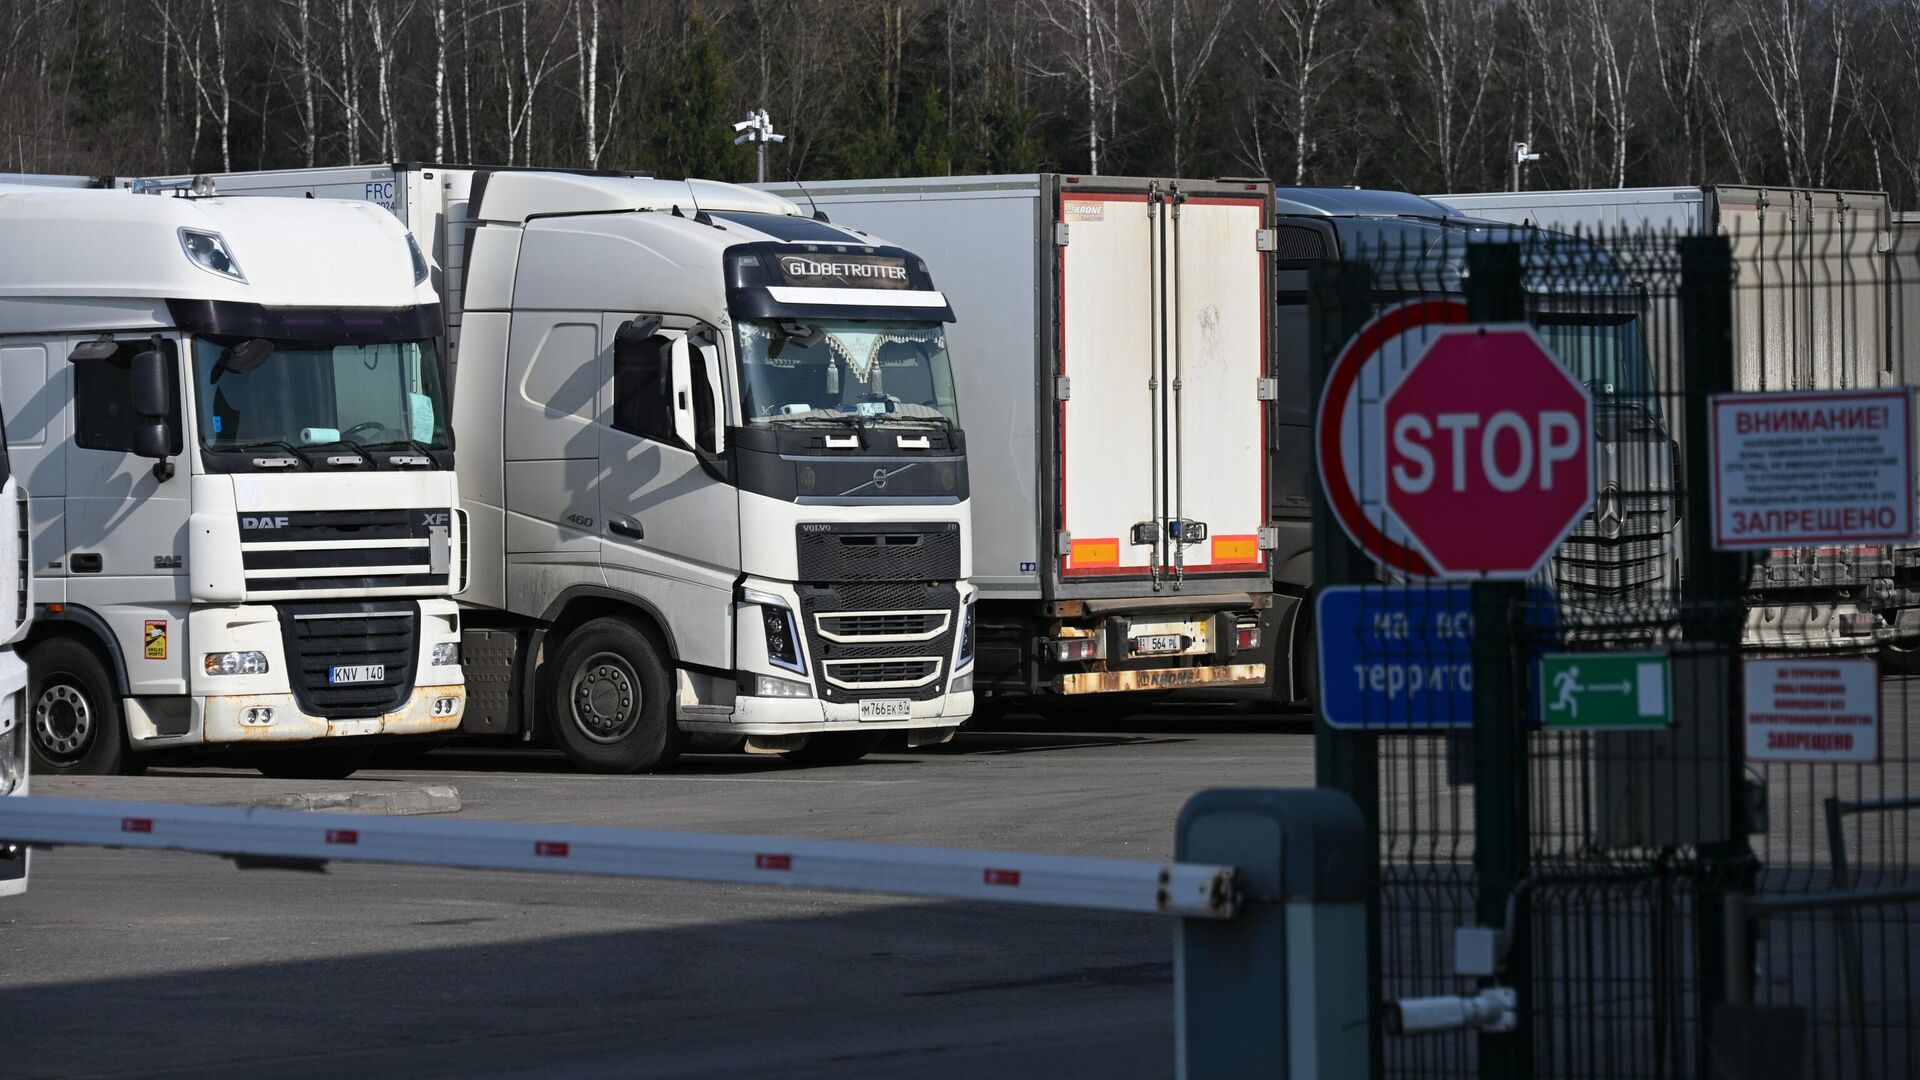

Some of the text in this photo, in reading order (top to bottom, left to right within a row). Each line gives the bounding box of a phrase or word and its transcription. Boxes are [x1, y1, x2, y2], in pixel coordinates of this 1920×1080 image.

[365, 183, 393, 200] FRC
[376, 201, 396, 211] 024
[1074, 206, 1103, 214] KRONE
[789, 262, 907, 280] GLOBETROTTER
[1735, 406, 1889, 434] ВНИМАНИЕ!
[1392, 410, 1581, 494] STOP
[242, 516, 289, 530] DAF
[421, 513, 449, 526] XF
[567, 514, 594, 527] 460
[1732, 506, 1897, 535] ЗАПРЕЩЕНО
[802, 524, 831, 532] VOLVO
[1374, 612, 1474, 640] на вс
[1152, 637, 1166, 650] 564
[335, 667, 358, 682] KNV
[366, 666, 383, 680] 140
[1353, 663, 1474, 700] террито
[1767, 732, 1853, 752] ЗАПРЕЩЕНО
